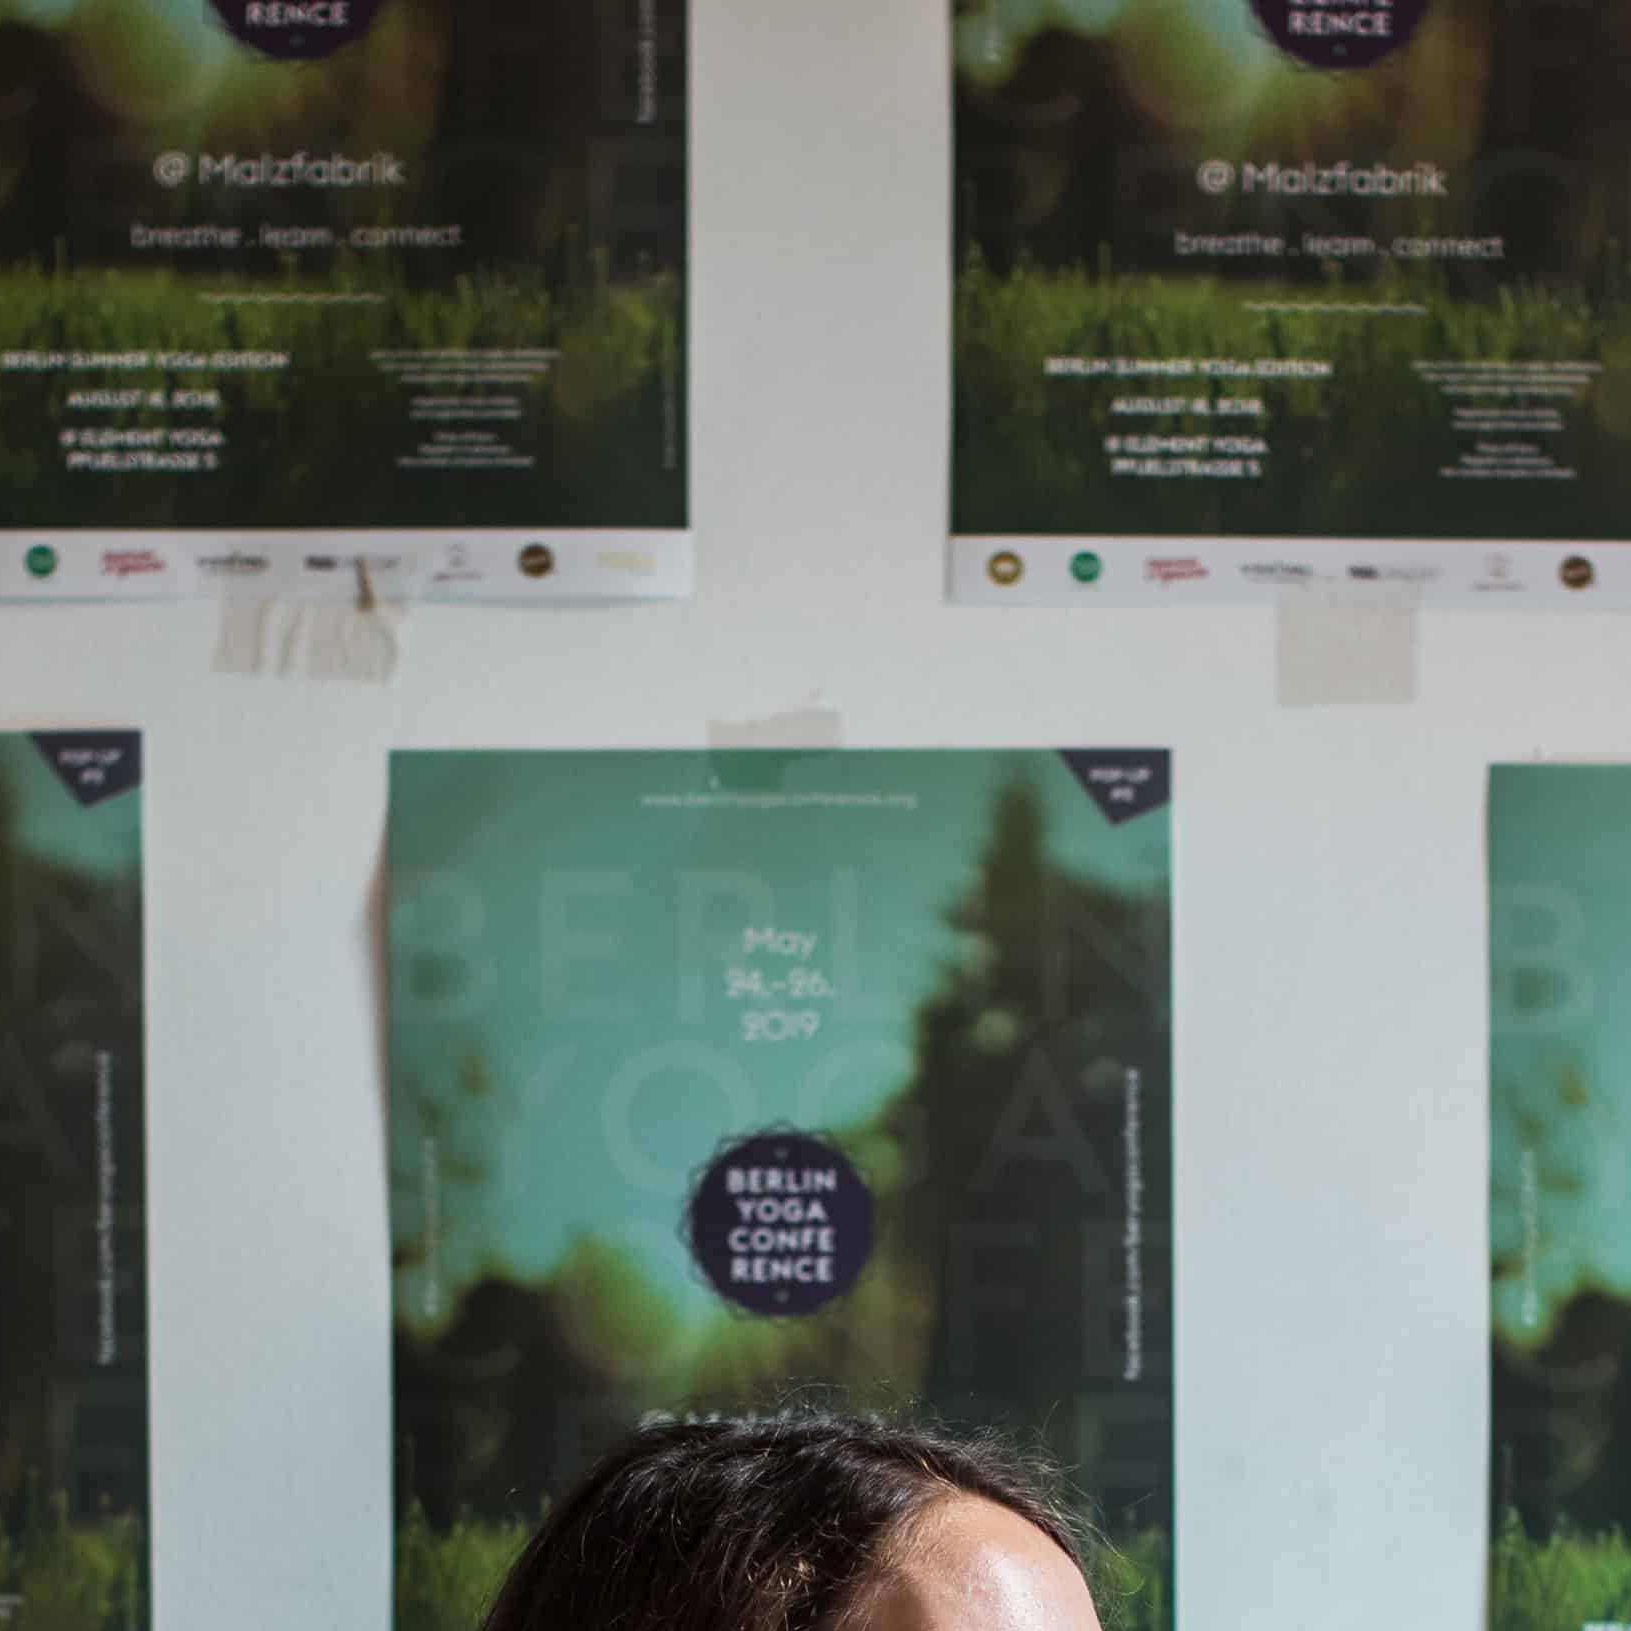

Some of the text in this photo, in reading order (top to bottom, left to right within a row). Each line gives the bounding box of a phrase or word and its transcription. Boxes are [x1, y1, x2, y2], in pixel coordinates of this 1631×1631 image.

[243, 0, 348, 28] RENCE
[1286, 8, 1391, 38] RENCE
[1196, 158, 1447, 198] @ Malzfabrik
[1175, 230, 1504, 259] breathe learn connect
[744, 925, 817, 960] May
[741, 1009, 819, 1041] 2019
[726, 1165, 837, 1194] BERLIN
[734, 1195, 828, 1224] YOGA
[726, 1224, 836, 1253] CONFE
[729, 1254, 835, 1284] RENCE
